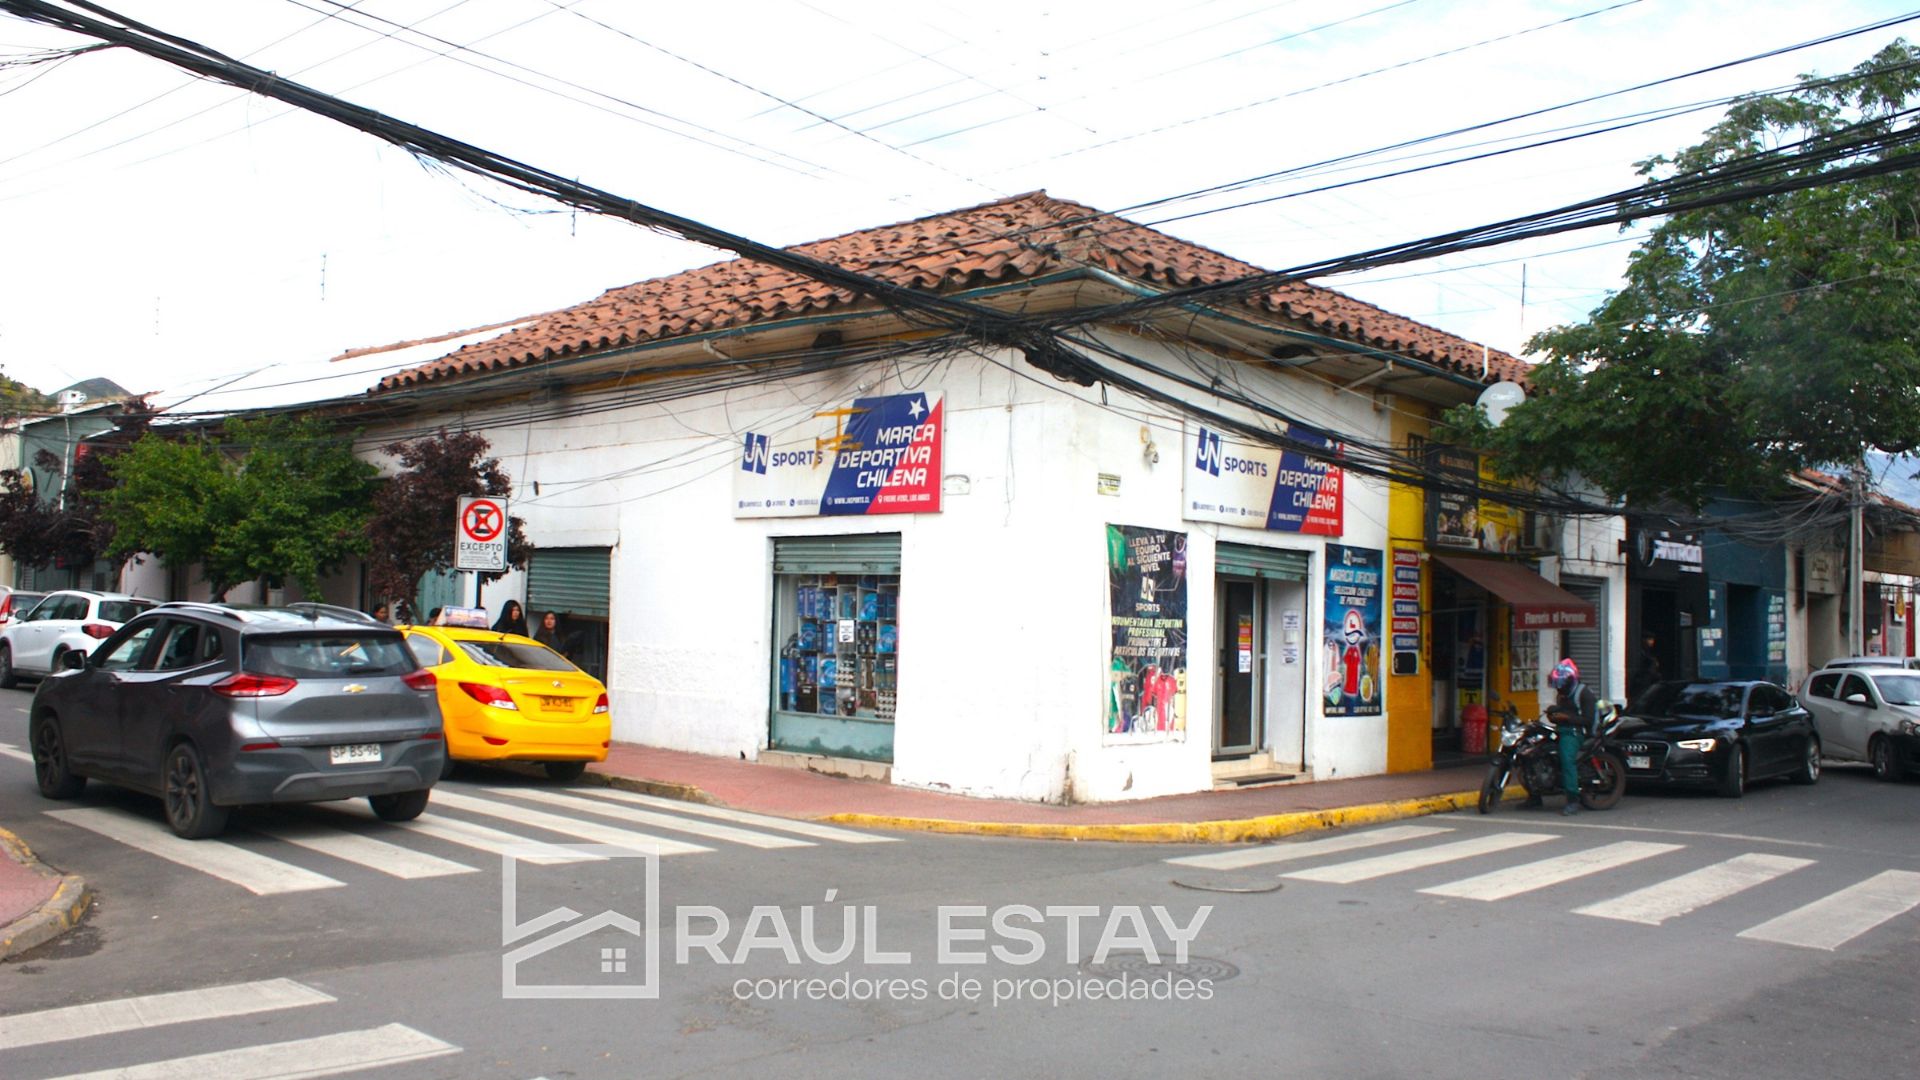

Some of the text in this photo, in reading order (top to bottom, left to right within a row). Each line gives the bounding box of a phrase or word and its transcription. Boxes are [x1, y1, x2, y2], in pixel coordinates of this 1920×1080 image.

[876, 423, 935, 446] MARCA
[742, 432, 823, 475] JN SPORTS
[839, 446, 931, 469] DEPORTIVA
[1196, 427, 1268, 478] JN SPORTS
[857, 467, 927, 489] CHILENA
[1279, 469, 1339, 495] DEPORTIVA
[1292, 490, 1336, 513] CHILENA
[460, 543, 503, 552] EXCEPTO
[1129, 534, 1166, 548] LLEVA A TU
[1135, 544, 1160, 556] EQUIPO
[1136, 551, 1171, 565] SIGUIENTE
[1141, 562, 1160, 573] NIVEL
[1135, 603, 1160, 612] SPORTS
